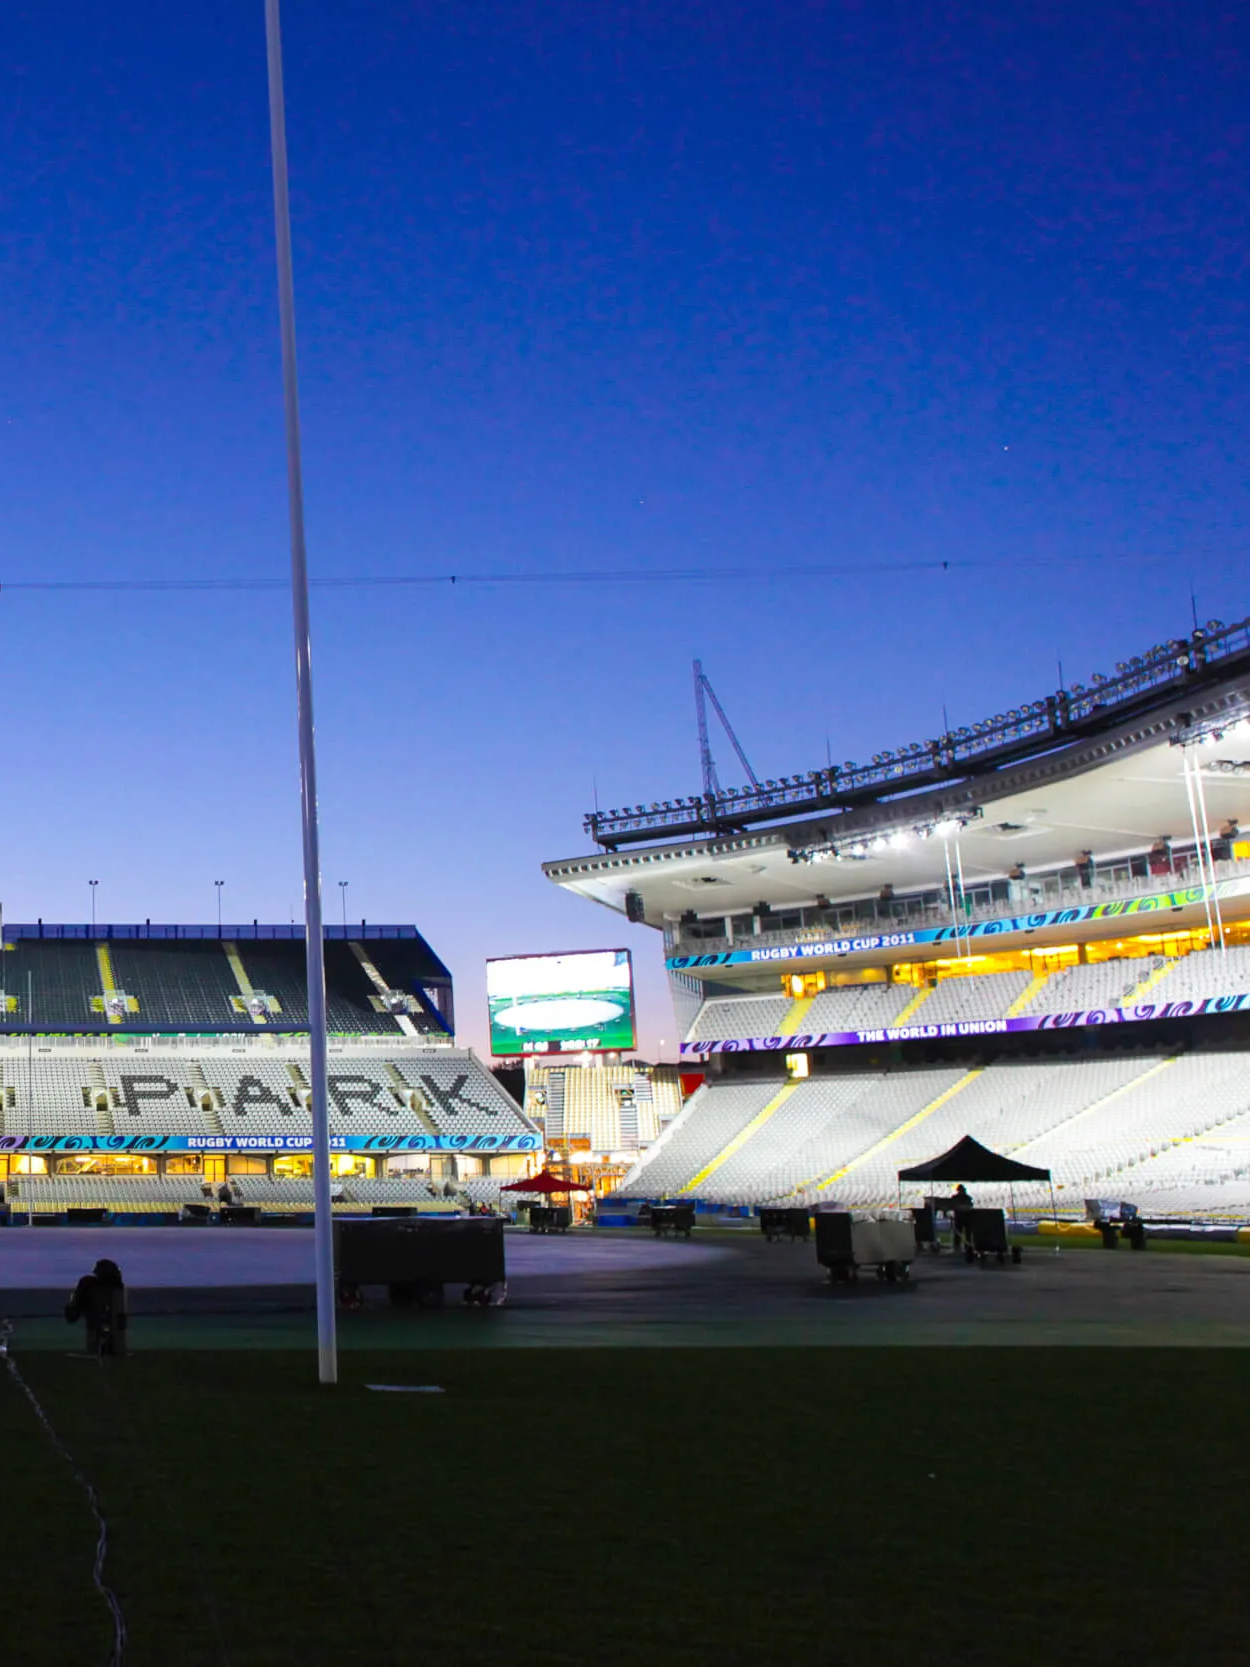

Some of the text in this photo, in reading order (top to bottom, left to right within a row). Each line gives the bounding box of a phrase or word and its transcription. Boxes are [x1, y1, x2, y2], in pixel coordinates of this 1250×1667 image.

[751, 933, 915, 961] RUGBY WORLD CUP 2011
[856, 1020, 1007, 1042] THE WORLD IN UNION
[119, 1074, 499, 1117] PARK
[187, 1137, 233, 1147] RUGBY
[236, 1137, 284, 1147] WORLD
[286, 1137, 313, 1147] CUP
